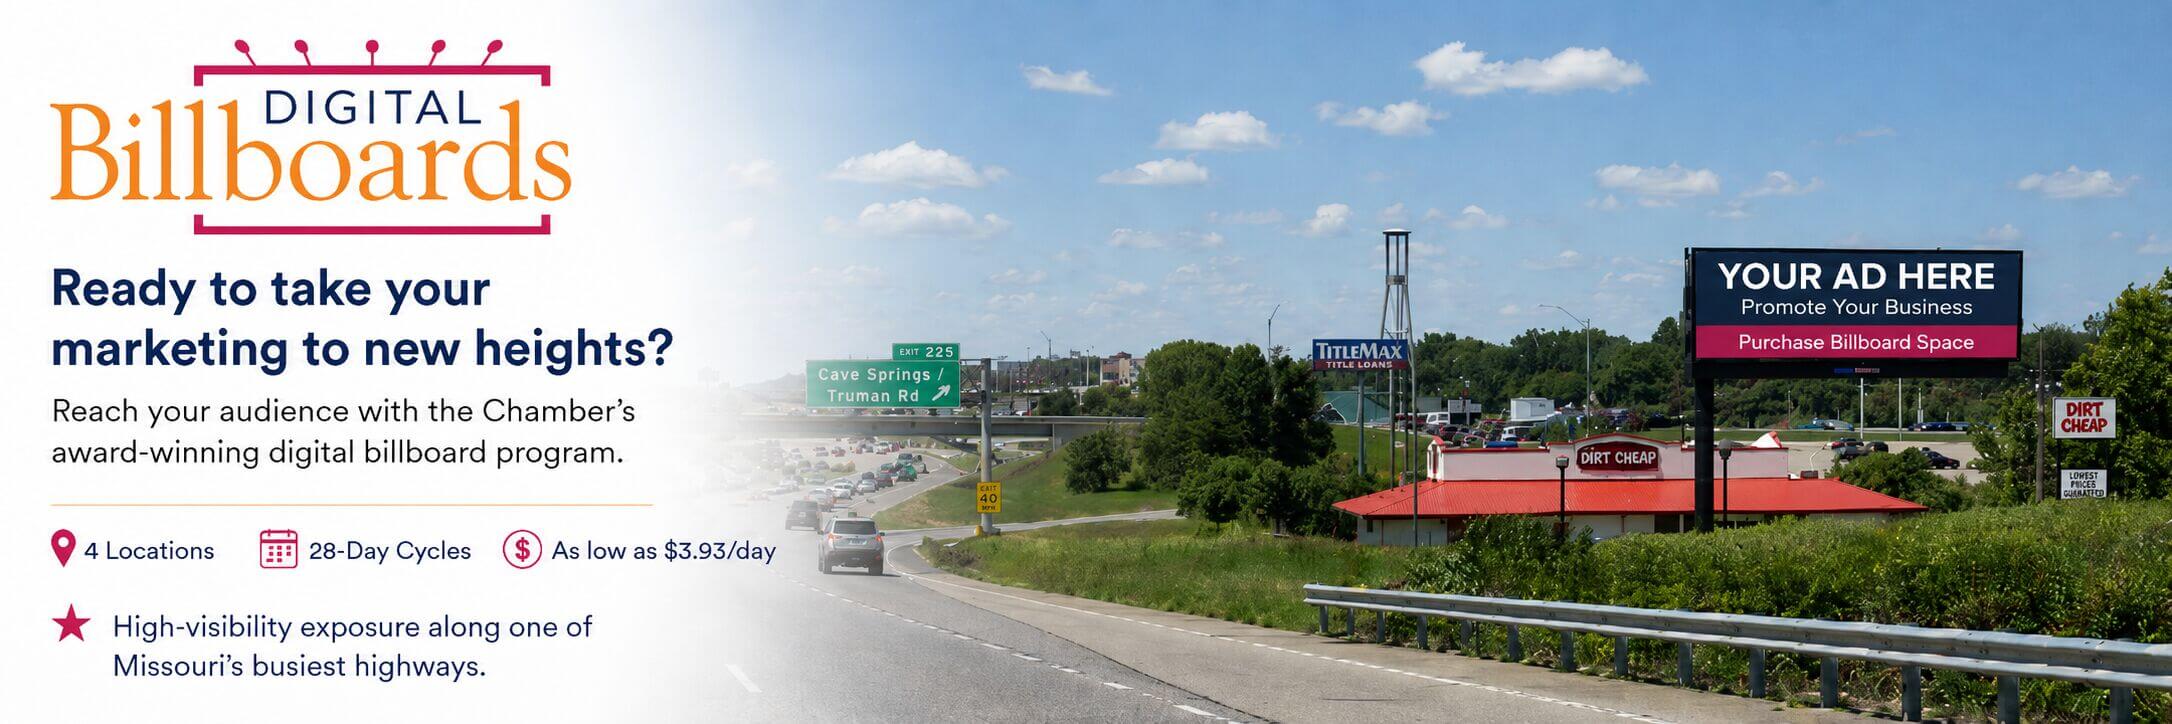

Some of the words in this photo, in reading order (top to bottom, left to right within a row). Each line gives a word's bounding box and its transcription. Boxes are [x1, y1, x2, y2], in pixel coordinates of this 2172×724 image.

[1718, 262, 1822, 291] YOUR
[1833, 262, 1887, 290] AD
[1899, 262, 1995, 290] HERE
[1741, 298, 1827, 315] Promote
[1832, 298, 1880, 315] Your
[1885, 298, 1973, 315] Business
[1739, 333, 1825, 350] Purchase
[1830, 333, 1911, 350] Billboard
[1916, 333, 1975, 354] Space
[899, 348, 919, 356] EXIT
[925, 346, 954, 358] 225
[1326, 361, 1355, 369] TITLE
[1358, 361, 1393, 369] LOANS
[818, 368, 860, 381] Cave
[867, 368, 931, 383] Springs
[937, 367, 944, 381] /
[827, 389, 890, 402] Truman
[899, 389, 919, 402] Rd
[2066, 402, 2104, 417] DIRT
[2061, 418, 2108, 433] CHEAP
[1581, 451, 1611, 465] DIRT
[1615, 451, 1656, 465] CHEAP
[980, 493, 998, 504] 40
